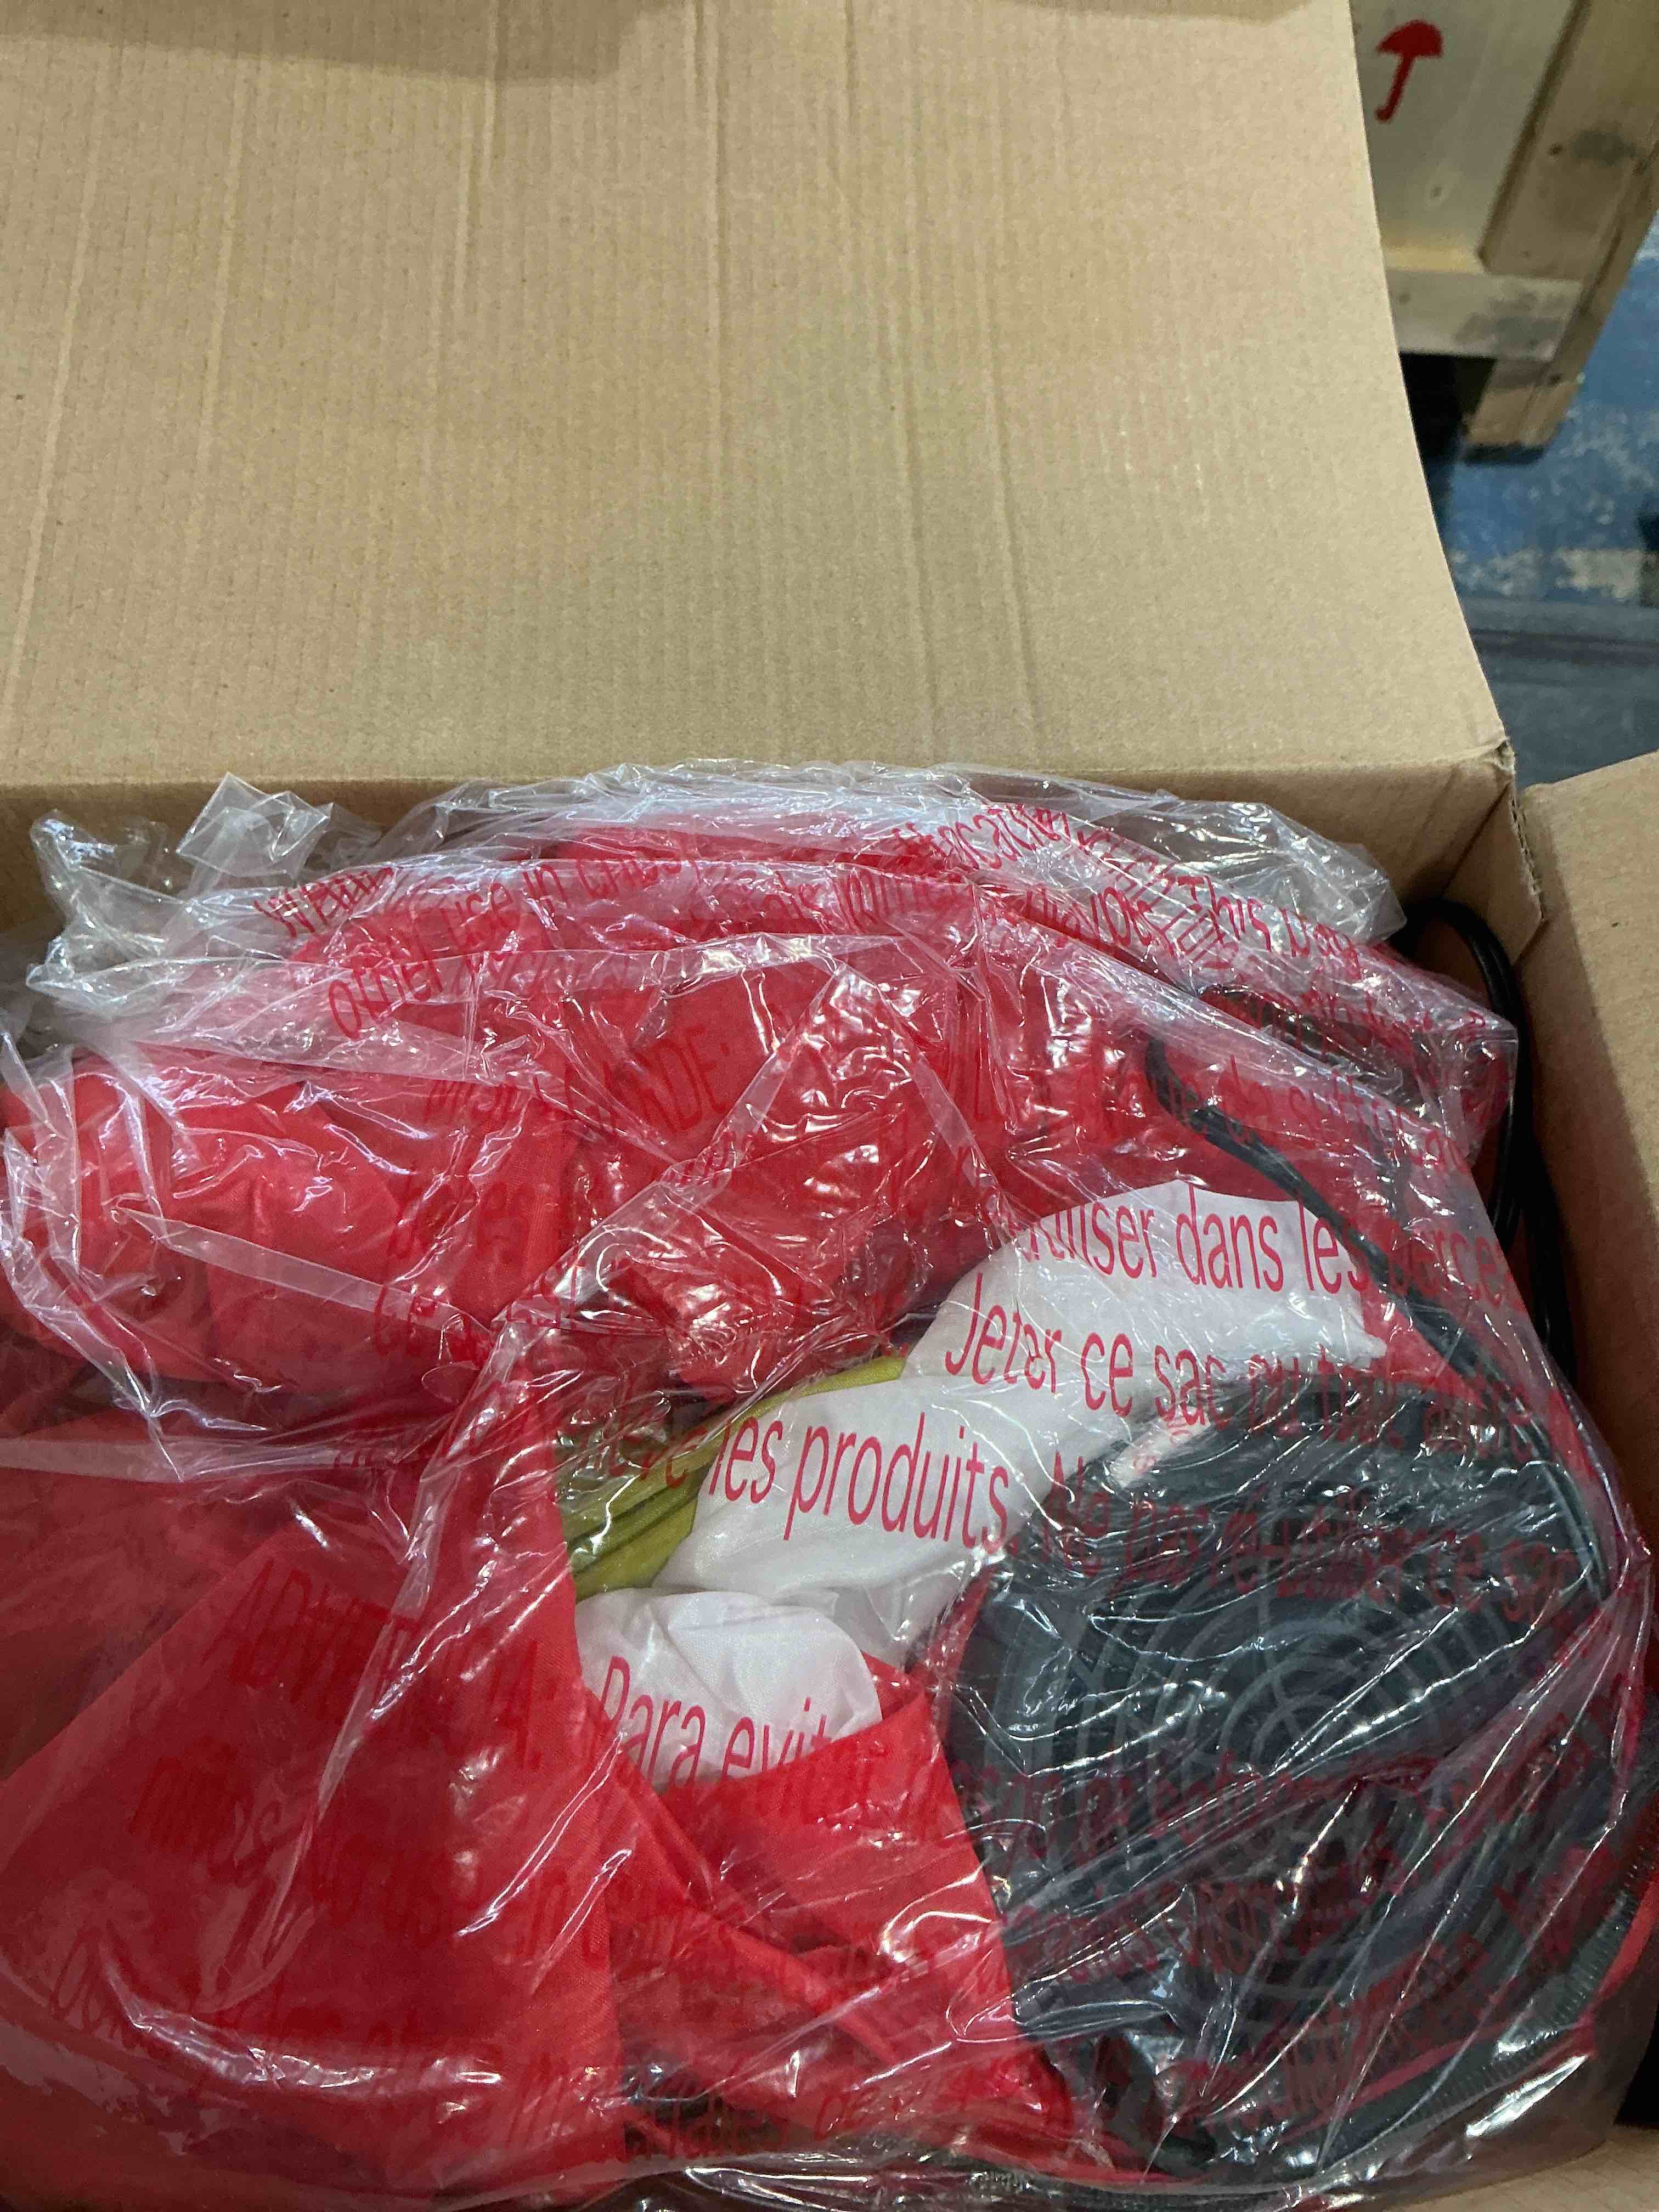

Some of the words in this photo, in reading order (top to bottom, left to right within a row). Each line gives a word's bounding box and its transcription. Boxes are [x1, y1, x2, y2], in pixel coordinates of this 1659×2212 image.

[1175, 1181, 1284, 1293] dans
[1296, 1198, 1370, 1294] les
[945, 1272, 1063, 1393] Jeter
[1080, 1332, 1133, 1417] ce
[1154, 1344, 1230, 1430] sac
[708, 1415, 783, 1504] les
[594, 1655, 706, 1790] Para
